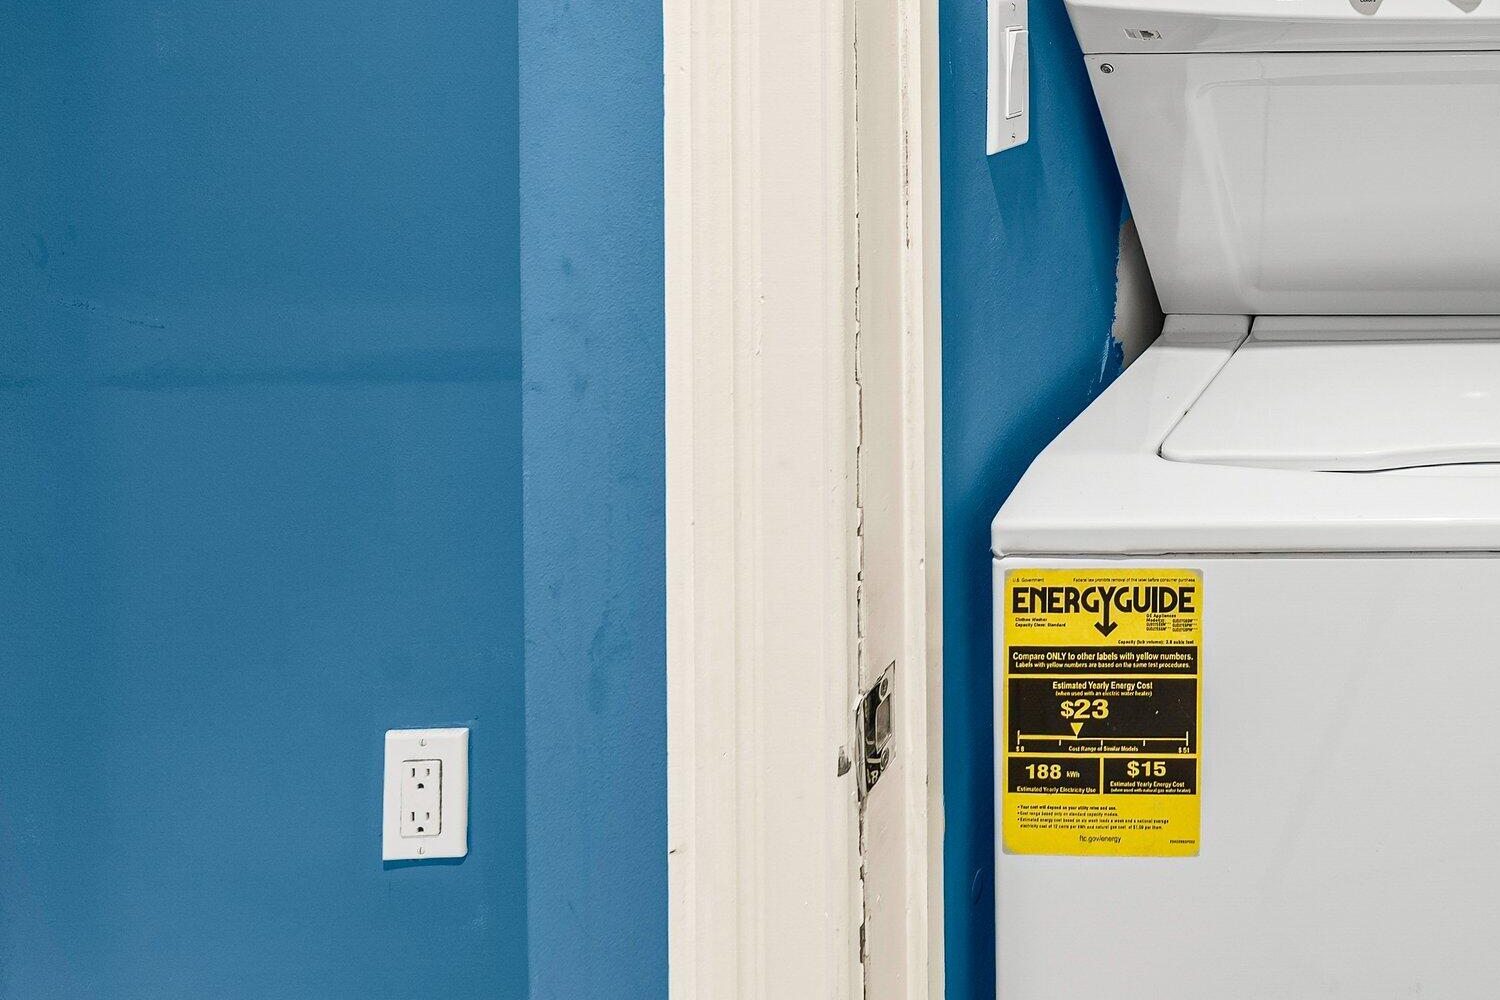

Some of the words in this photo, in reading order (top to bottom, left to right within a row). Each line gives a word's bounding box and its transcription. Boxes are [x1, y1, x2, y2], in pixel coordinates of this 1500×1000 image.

[1013, 587, 1195, 613] ENERGYGUIDE
[1012, 652, 1045, 662] Compare
[1046, 652, 1067, 660] ONLY
[1067, 652, 1076, 660] to
[1077, 652, 1096, 660] other
[1096, 652, 1118, 660] labels
[1119, 652, 1135, 660] with
[1136, 652, 1159, 662] yellow
[1160, 652, 1193, 660] numbers.
[1053, 681, 1087, 689] Estimated
[1088, 681, 1110, 691] Yearly
[1110, 681, 1135, 691] Energy
[1136, 681, 1153, 689] Cost
[1060, 698, 1109, 720] $23
[1025, 764, 1061, 779] 188
[1127, 760, 1167, 778] $15
